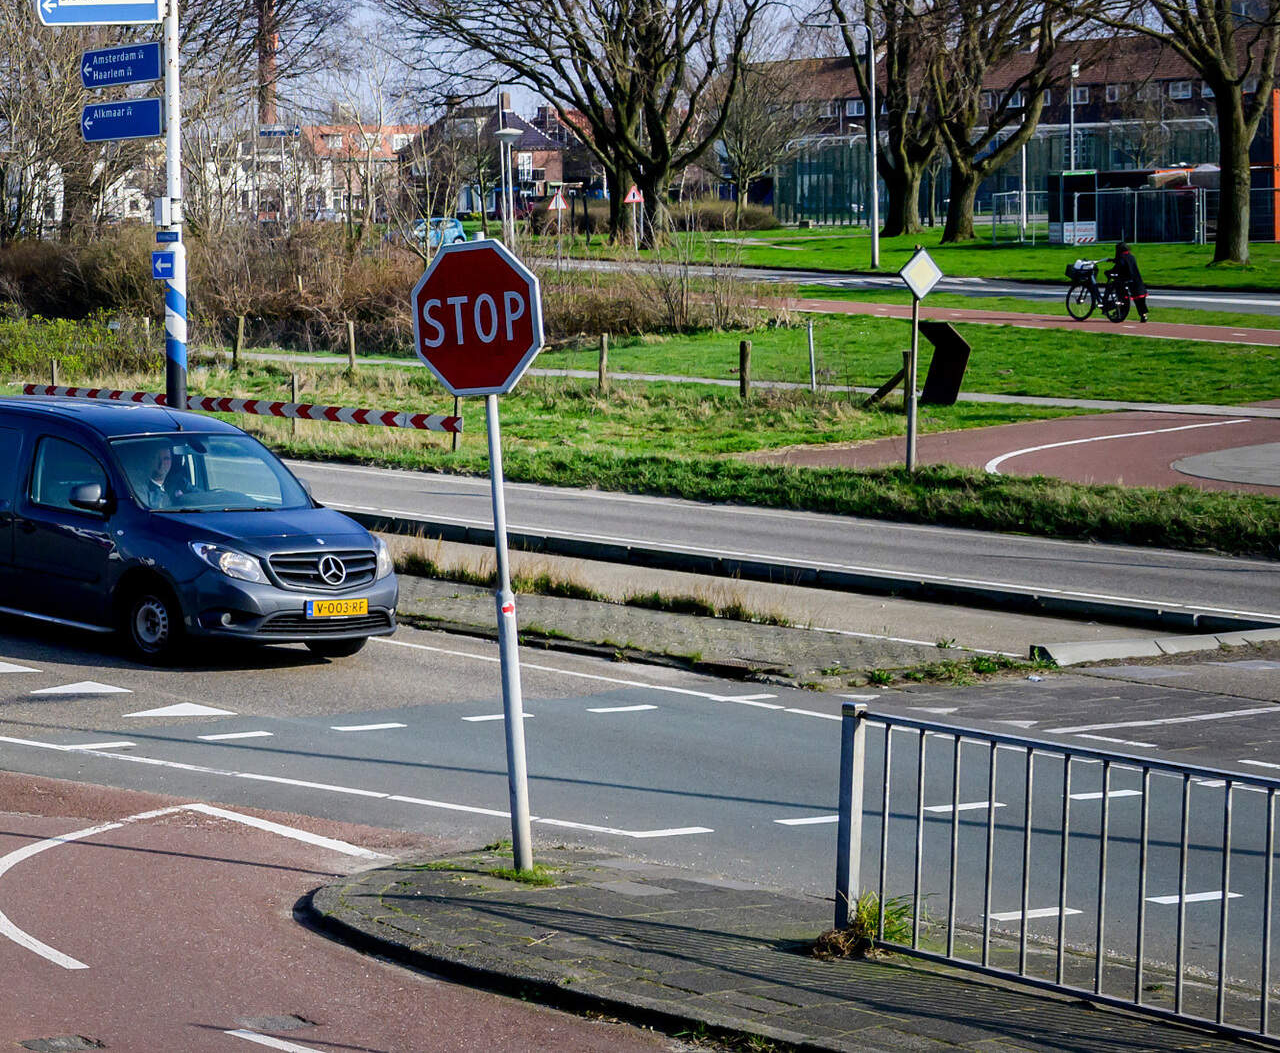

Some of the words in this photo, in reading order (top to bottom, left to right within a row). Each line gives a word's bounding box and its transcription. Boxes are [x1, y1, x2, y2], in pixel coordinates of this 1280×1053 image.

[93, 50, 137, 65] Amsterdam
[93, 68, 125, 80] Haarlem
[93, 108, 125, 119] Alkmaar
[423, 291, 525, 348] STOP
[317, 601, 365, 614] V-003-RF
